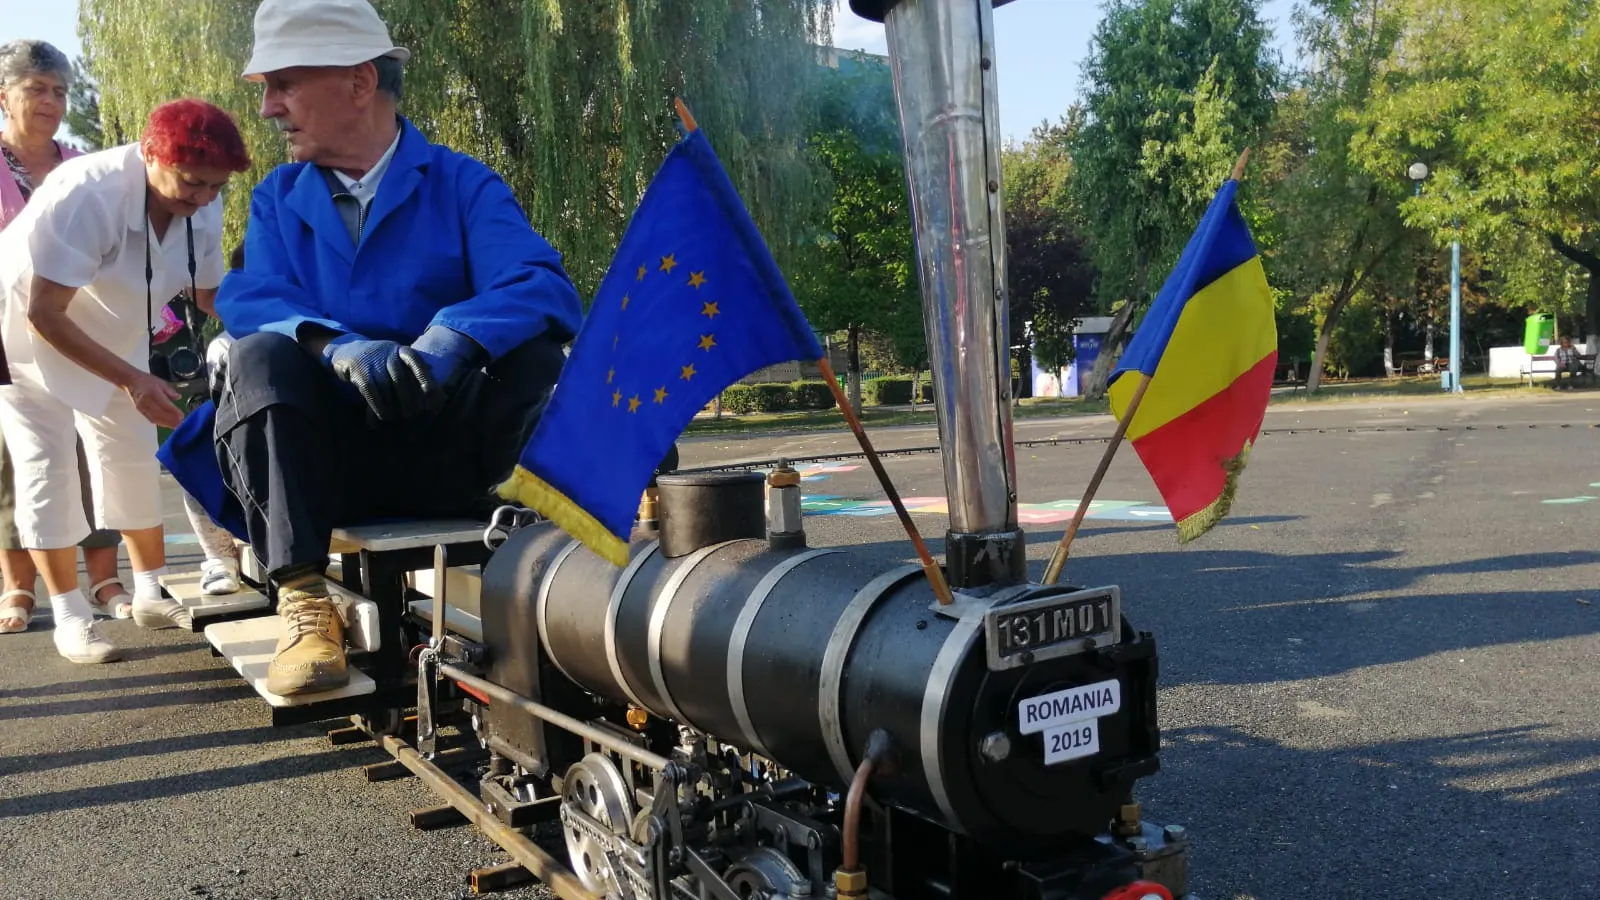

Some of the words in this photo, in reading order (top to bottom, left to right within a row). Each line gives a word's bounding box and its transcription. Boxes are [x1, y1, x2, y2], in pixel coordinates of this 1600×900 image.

[999, 601, 1109, 647] 131M01
[1026, 687, 1114, 723] ROMANIA
[1051, 726, 1092, 753] 2019
